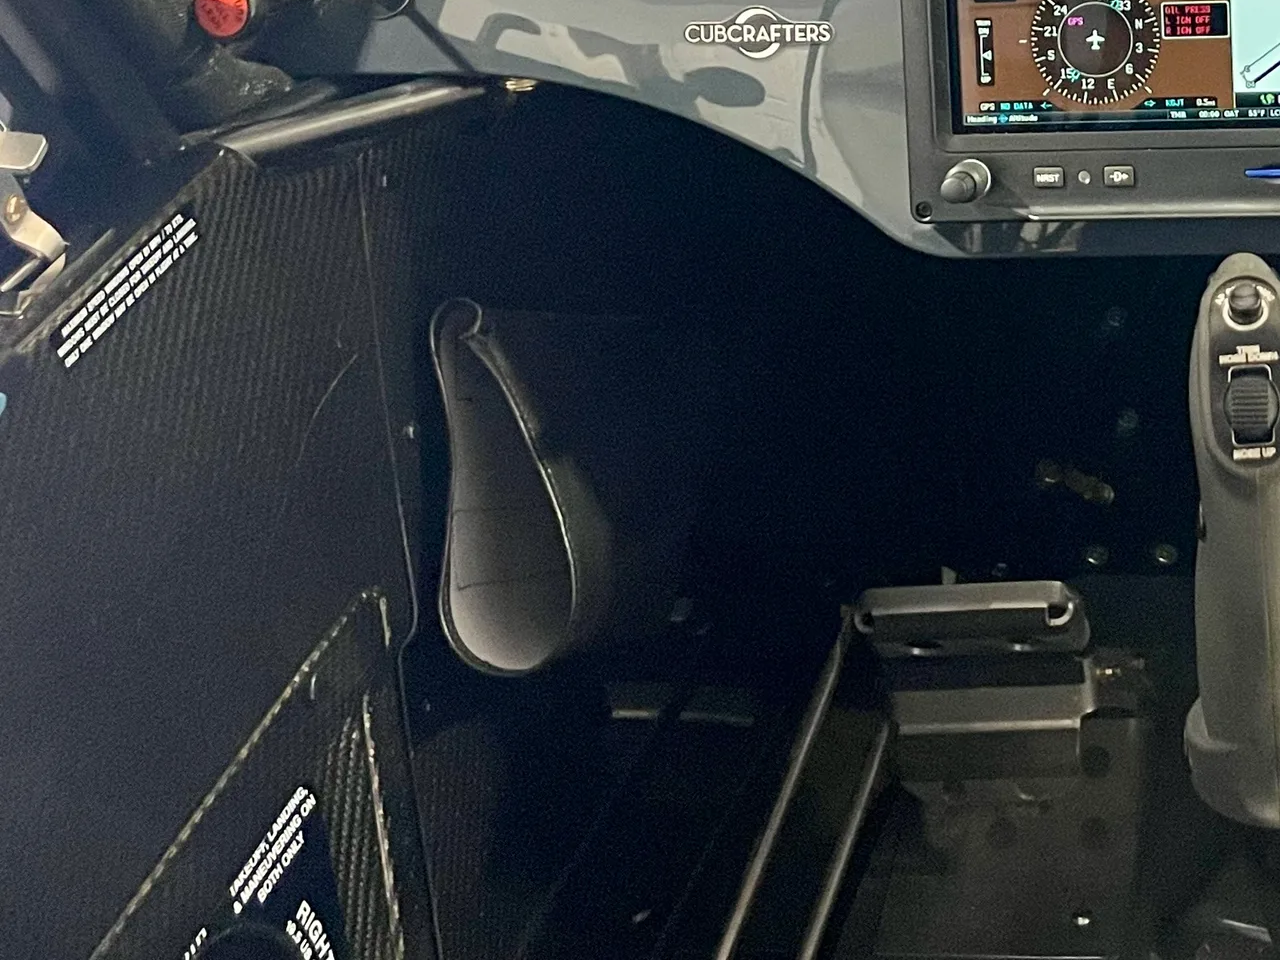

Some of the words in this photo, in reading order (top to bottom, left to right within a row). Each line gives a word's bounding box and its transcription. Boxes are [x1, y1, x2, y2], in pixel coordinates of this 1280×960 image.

[1054, 4, 1068, 16] 24
[1068, 17, 1084, 26] GPS
[1135, 19, 1143, 30] N
[684, 24, 830, 43] CUBCRAFTERS
[1044, 26, 1058, 37] 21
[1136, 42, 1143, 53] 3
[1126, 64, 1134, 74] 6
[1082, 78, 1094, 90] 12
[1108, 78, 1115, 90] E
[1036, 172, 1060, 184] NRST
[300, 794, 316, 817] ON
[257, 866, 284, 904] BOTH
